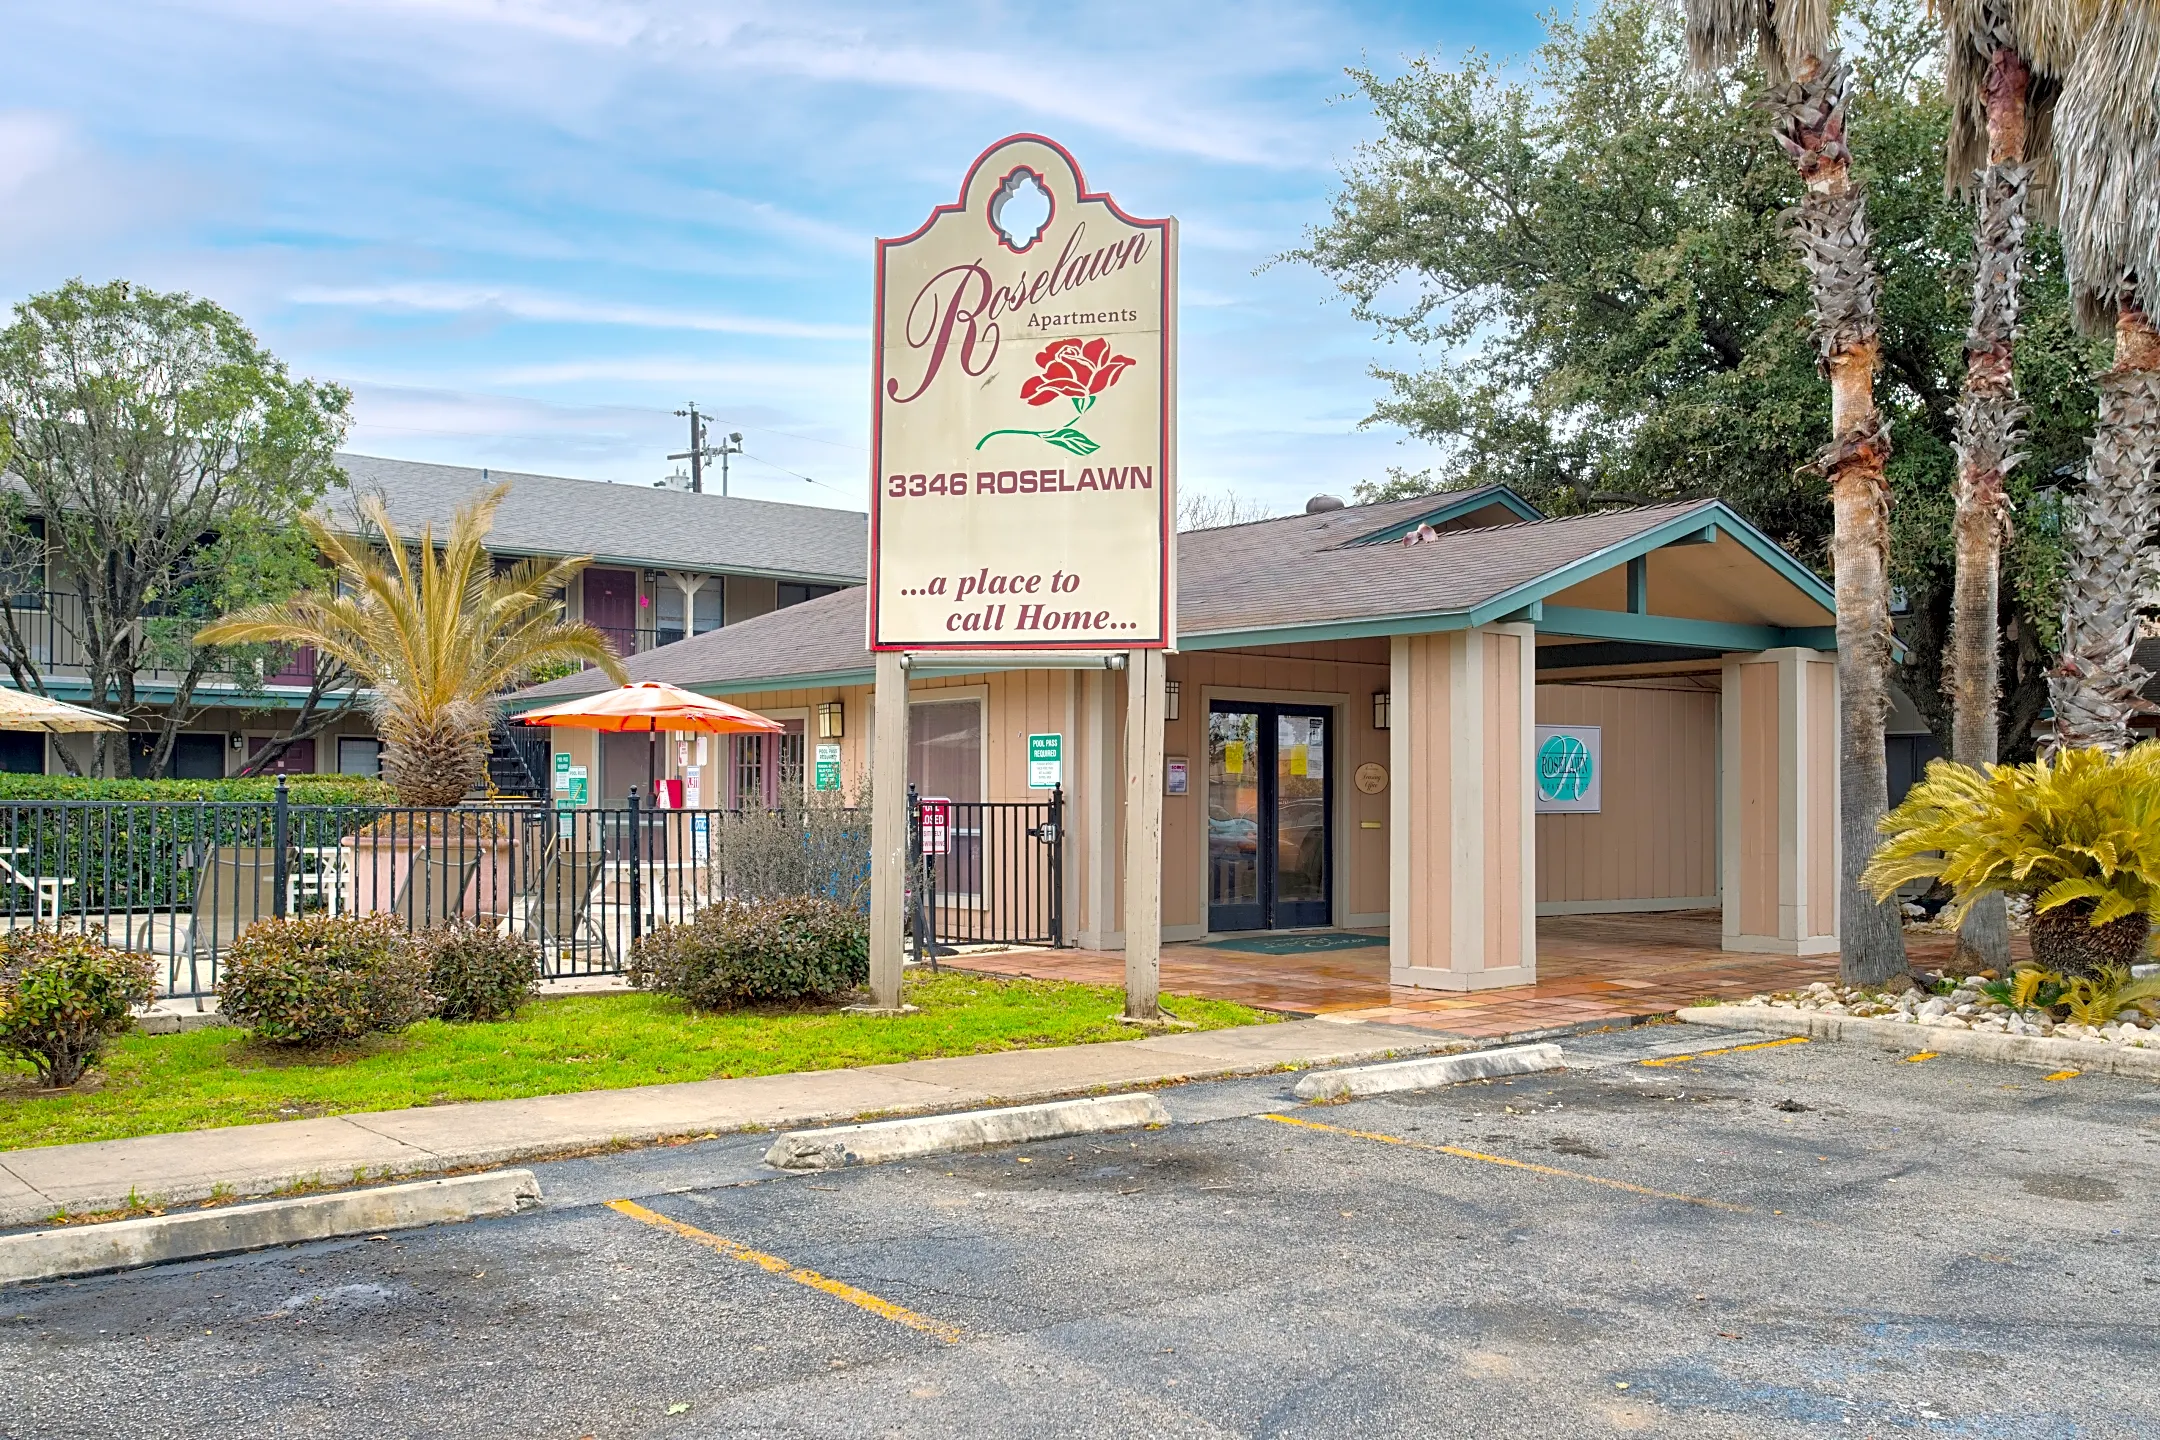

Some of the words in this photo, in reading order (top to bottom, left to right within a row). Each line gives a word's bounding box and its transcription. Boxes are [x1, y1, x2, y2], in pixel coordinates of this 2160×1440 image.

[887, 222, 1152, 403] Roselawn
[1027, 308, 1137, 330] Apartments
[889, 473, 967, 497] 3346
[977, 466, 1152, 494] ROSELAWN
[954, 568, 1041, 601] place
[1051, 569, 1080, 593] to
[946, 604, 1005, 631] call
[1014, 604, 1137, 630] Home...
[1046, 739, 1058, 747] PASS
[1542, 757, 1588, 774] ROSELAWN
